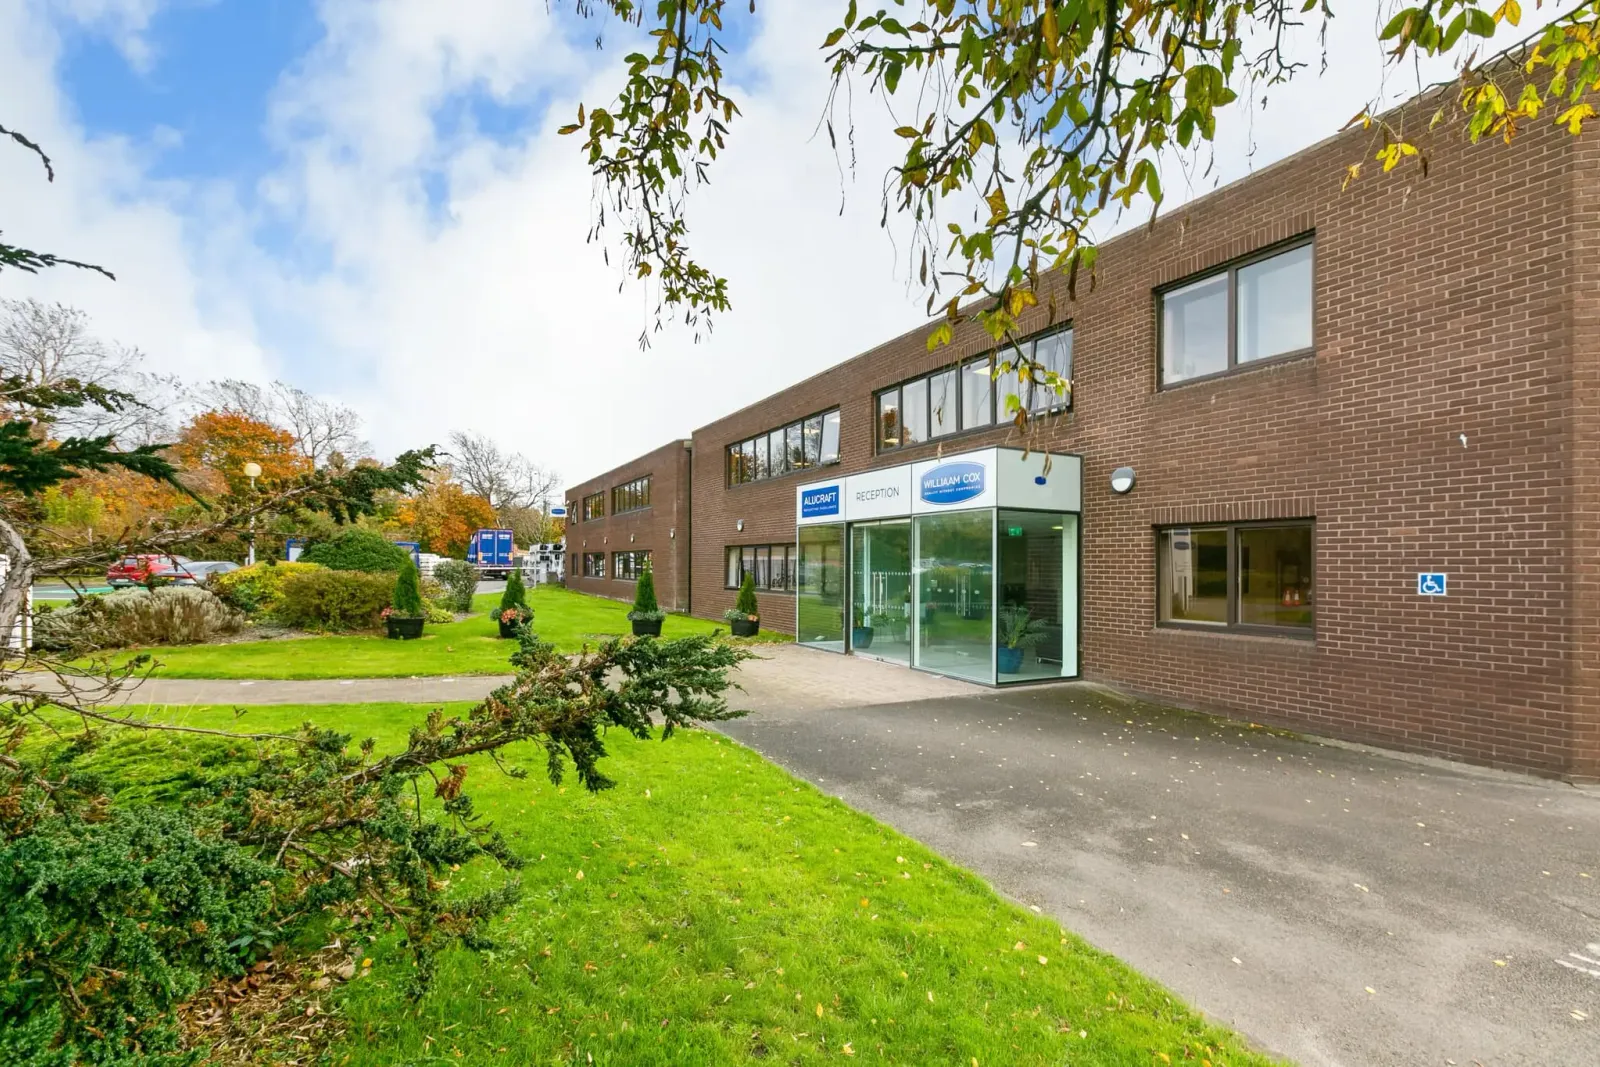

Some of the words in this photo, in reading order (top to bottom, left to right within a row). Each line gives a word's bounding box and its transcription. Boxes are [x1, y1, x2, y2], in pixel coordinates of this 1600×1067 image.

[963, 472, 981, 484] COX
[804, 492, 837, 505] ALUCRAFT
[856, 486, 900, 502] RECEPTION
